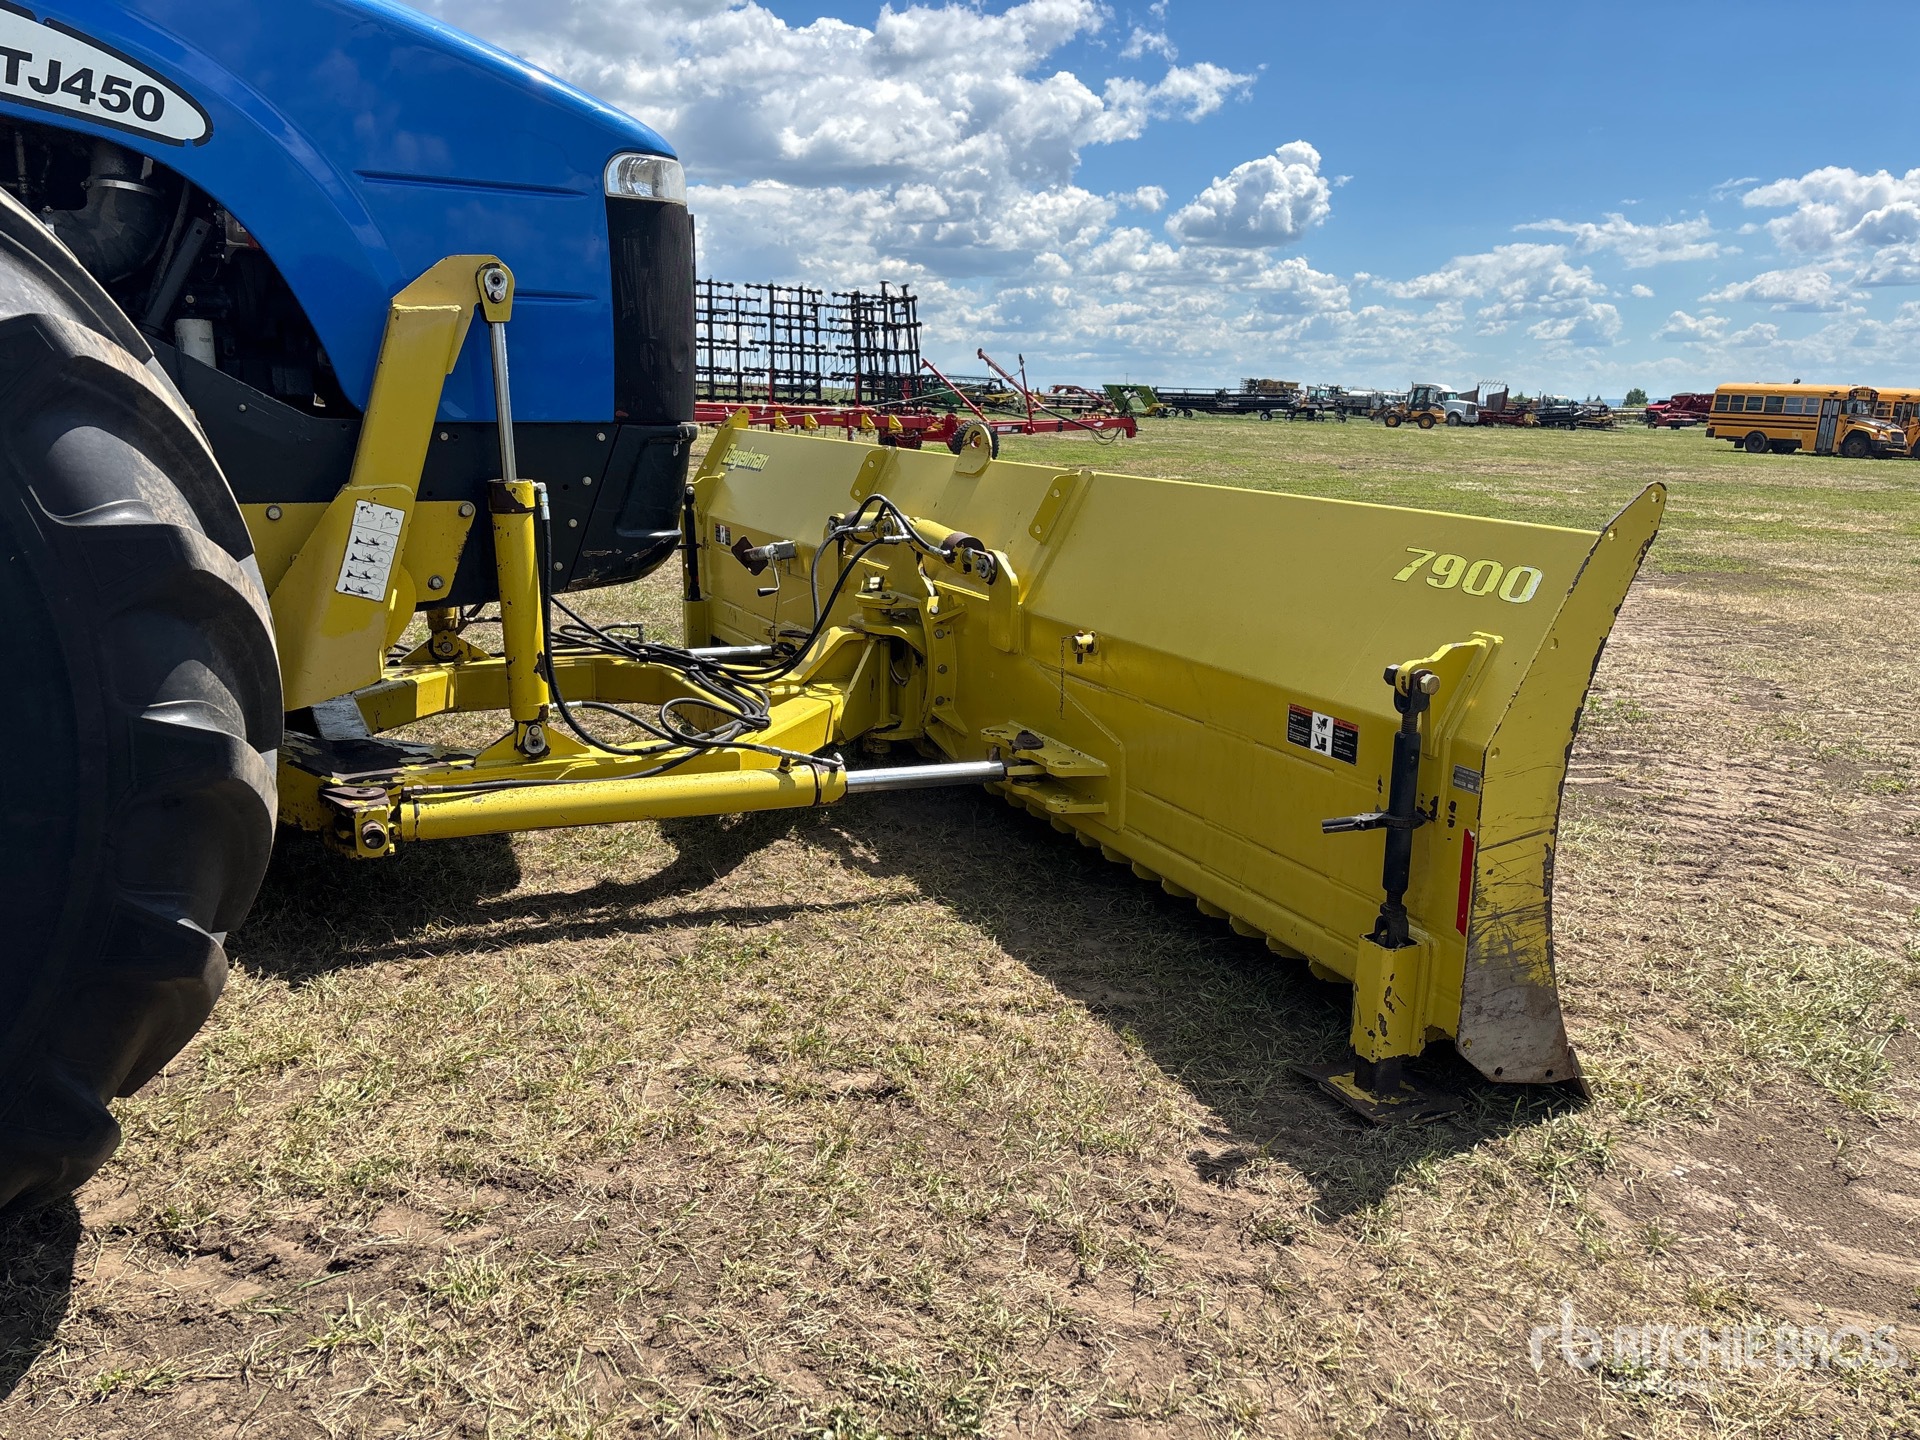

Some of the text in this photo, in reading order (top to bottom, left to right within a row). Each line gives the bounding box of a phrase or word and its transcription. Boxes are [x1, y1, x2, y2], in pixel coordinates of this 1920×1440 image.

[0, 46, 165, 122] TJ450
[721, 443, 770, 471] Degelman
[1392, 546, 1544, 604] 7900
